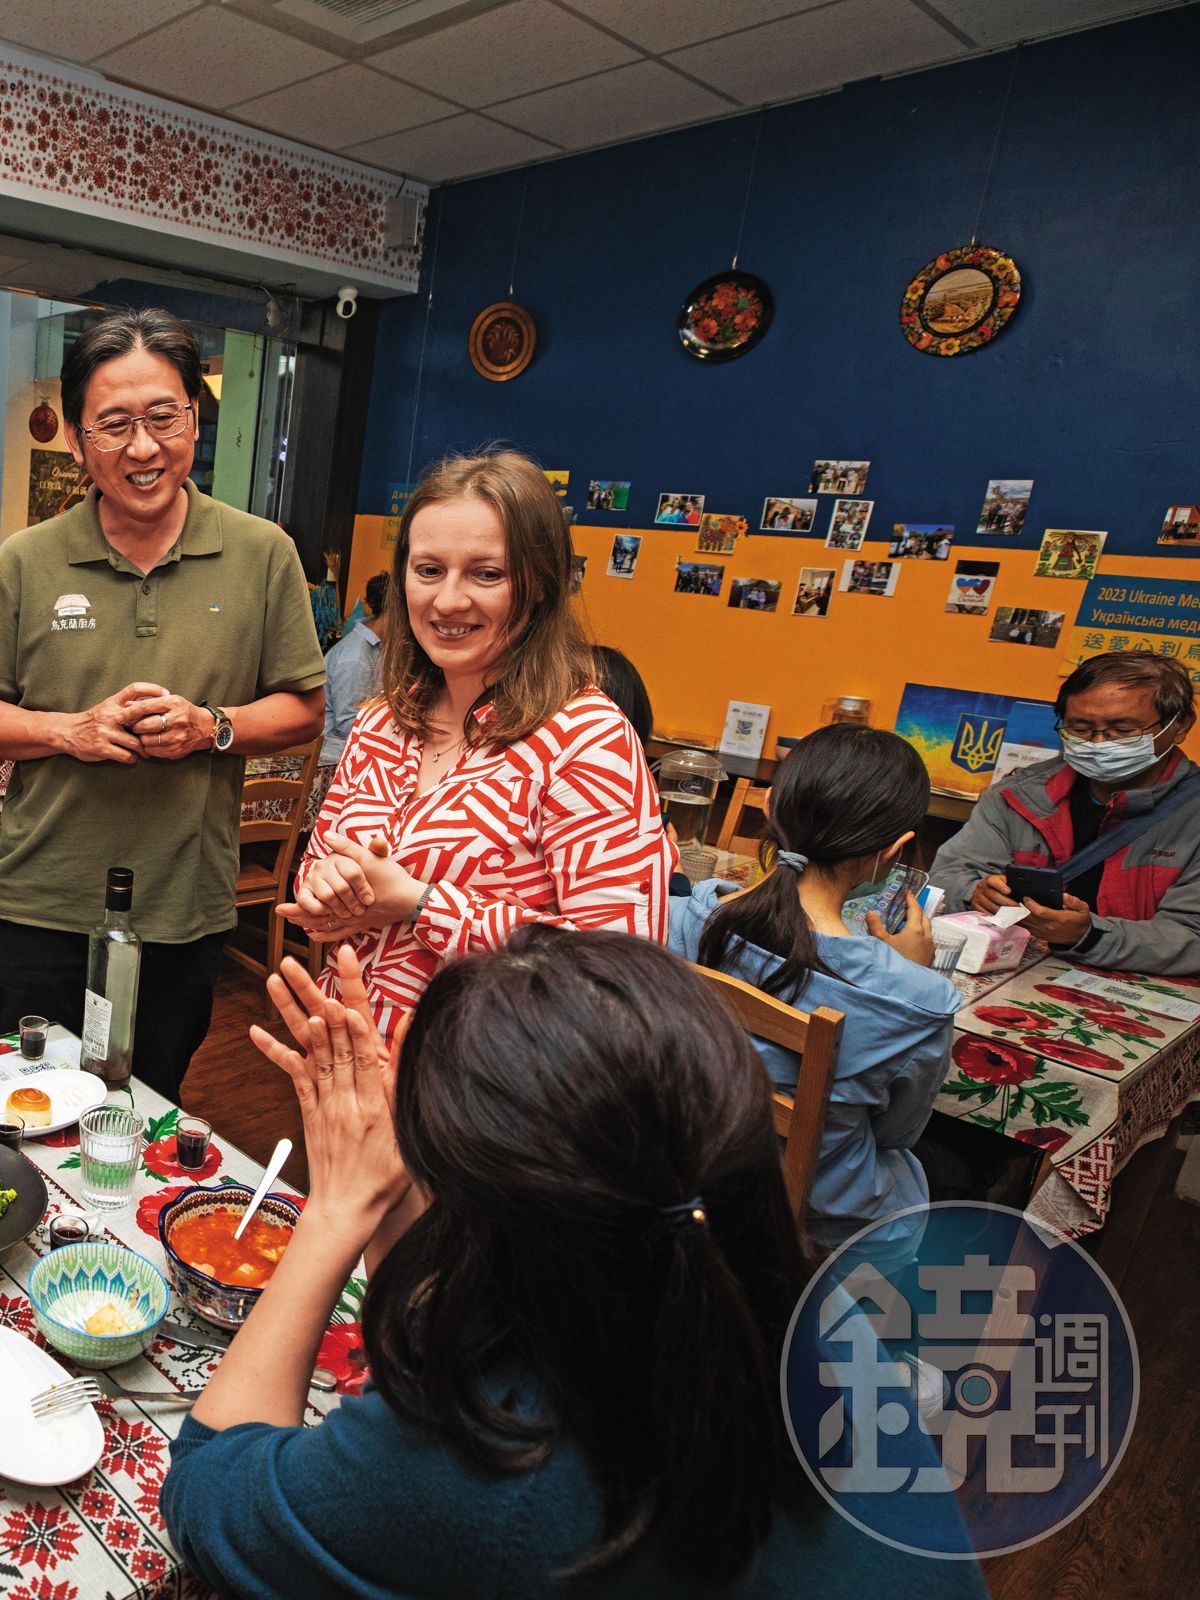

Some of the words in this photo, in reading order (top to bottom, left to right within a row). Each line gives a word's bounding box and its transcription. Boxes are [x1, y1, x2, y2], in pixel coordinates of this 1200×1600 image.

[1097, 587, 1127, 602] 2023
[1128, 589, 1176, 606] Ukraine
[50, 617, 97, 631] 烏克蘭廚房
[1091, 608, 1165, 626] Українська
